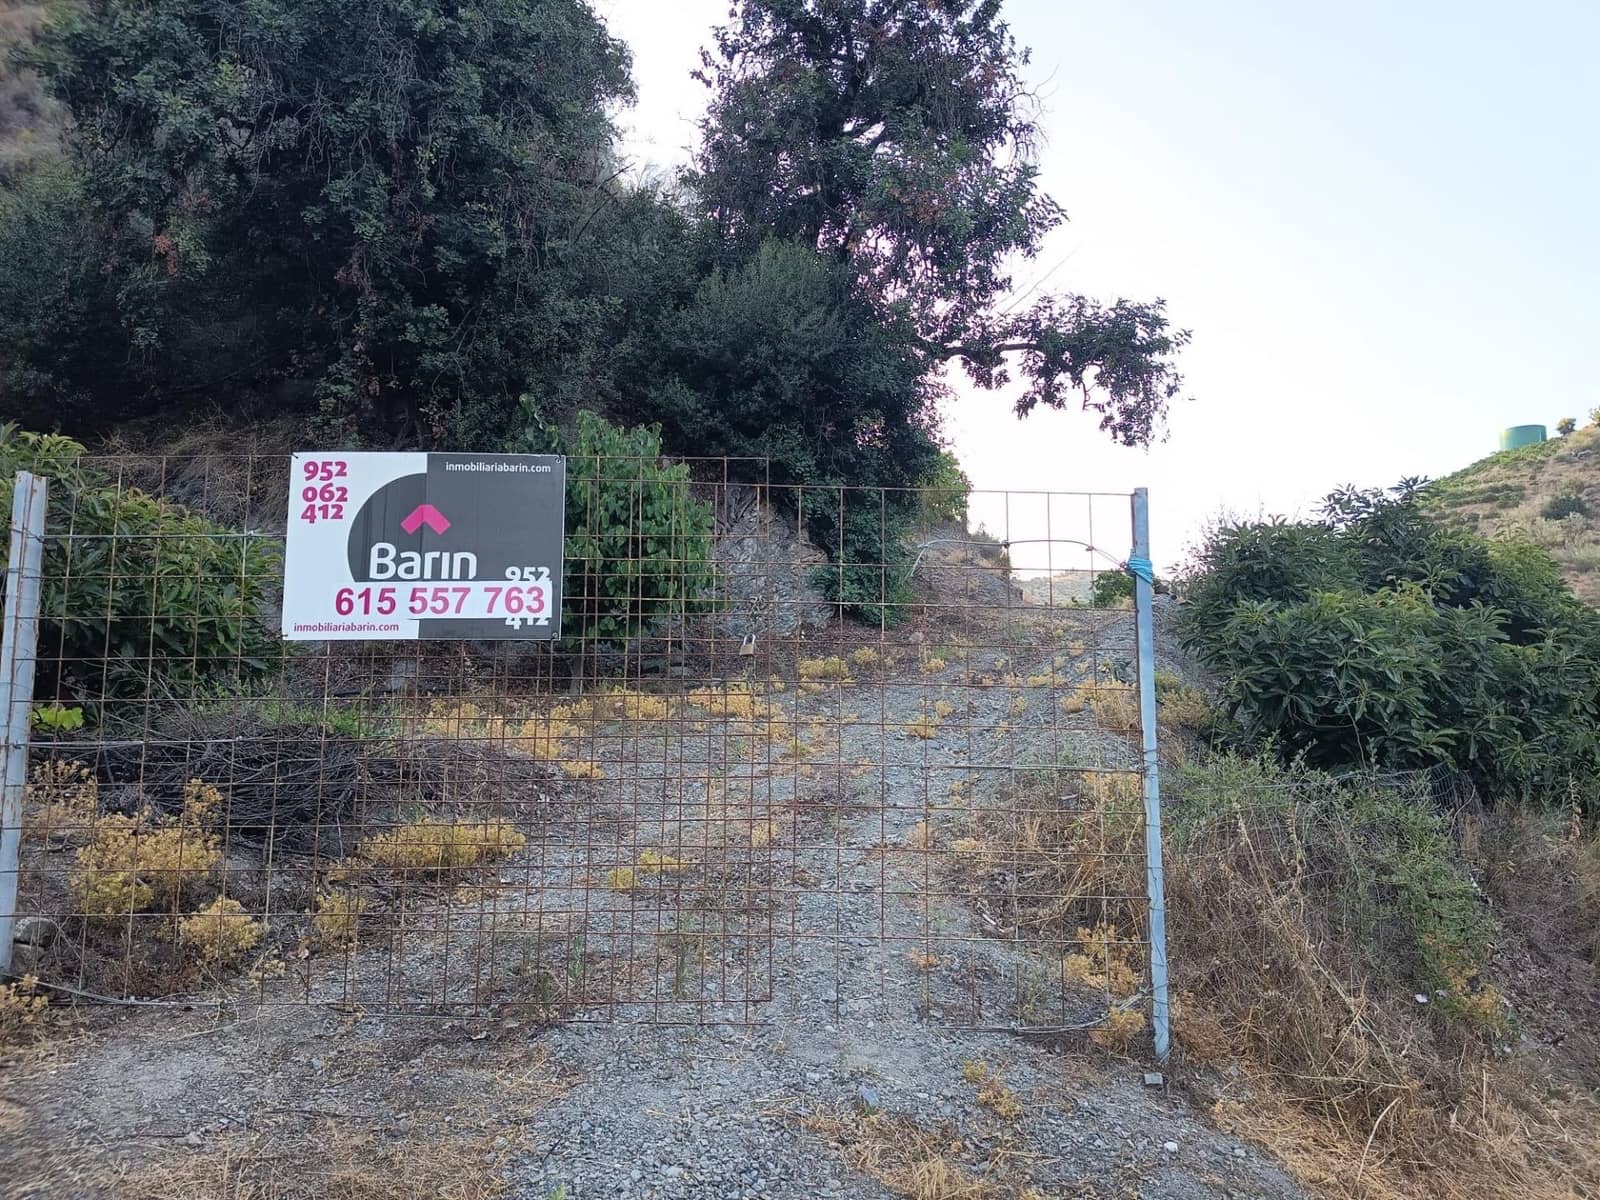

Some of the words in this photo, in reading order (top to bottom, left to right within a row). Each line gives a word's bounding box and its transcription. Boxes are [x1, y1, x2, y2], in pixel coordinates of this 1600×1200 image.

[303, 461, 348, 481] 952
[445, 461, 551, 473] inmobiliariabarin.com
[302, 482, 349, 503] 062
[300, 504, 344, 524] 412
[369, 542, 478, 580] Barin
[335, 587, 397, 616] 615
[408, 587, 471, 615] 557
[483, 586, 545, 614] 763
[293, 622, 400, 632] inmobiliariabarin.com
